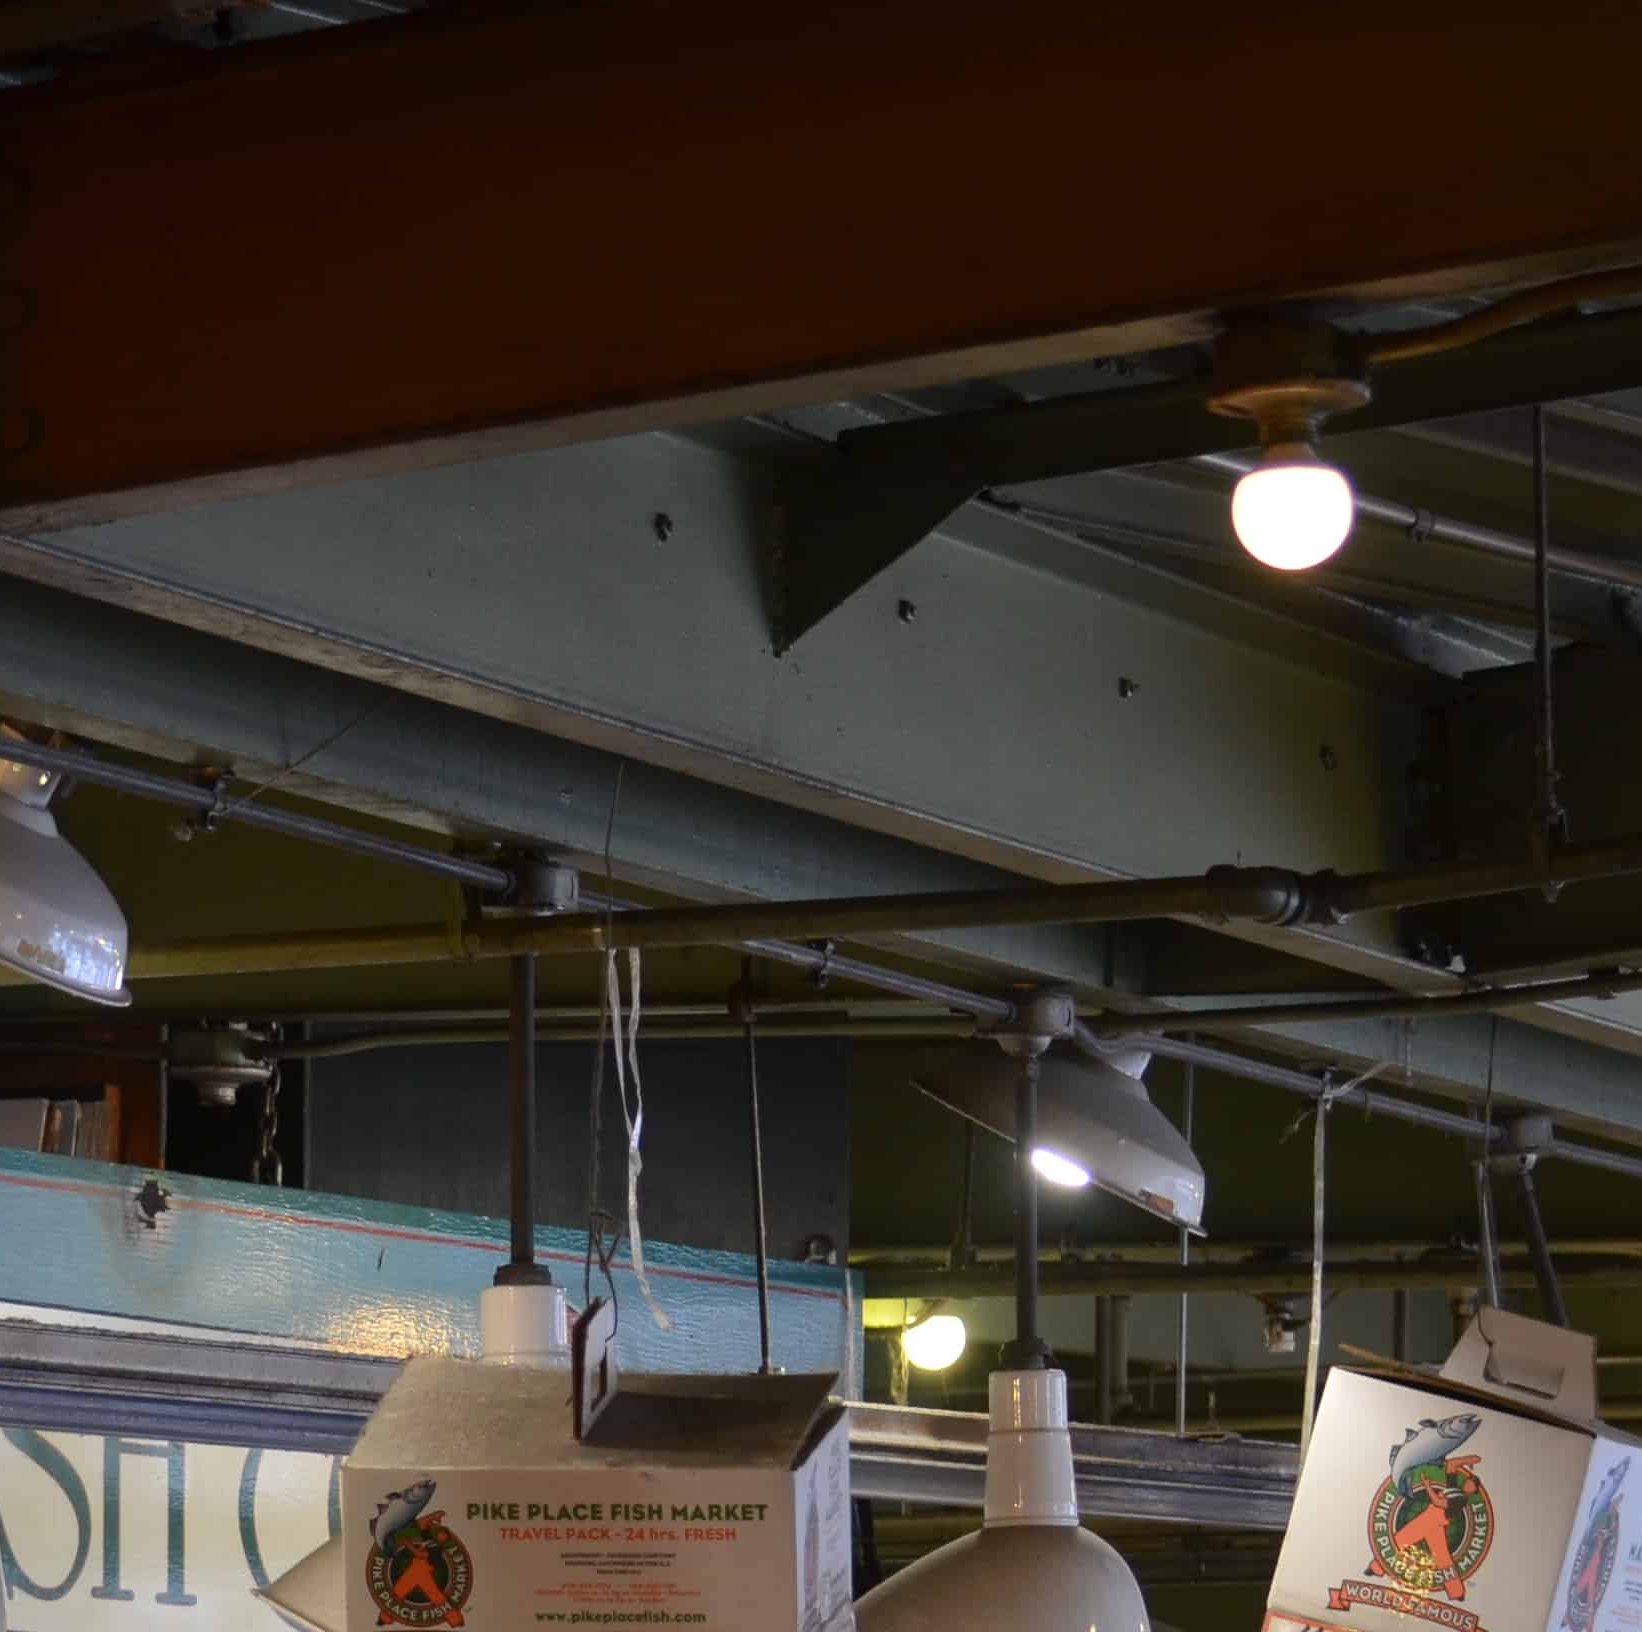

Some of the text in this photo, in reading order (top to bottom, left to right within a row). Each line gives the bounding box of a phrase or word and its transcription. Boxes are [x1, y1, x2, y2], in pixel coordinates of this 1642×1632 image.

[466, 1502, 768, 1522] PIKE PLACE FISH MARKET
[499, 1526, 737, 1543] TRAVEL PACK 24 hrs. FRESH
[1373, 1491, 1488, 1571] PIKE MARKET
[1344, 1582, 1475, 1631] WORLD FAMOUS
